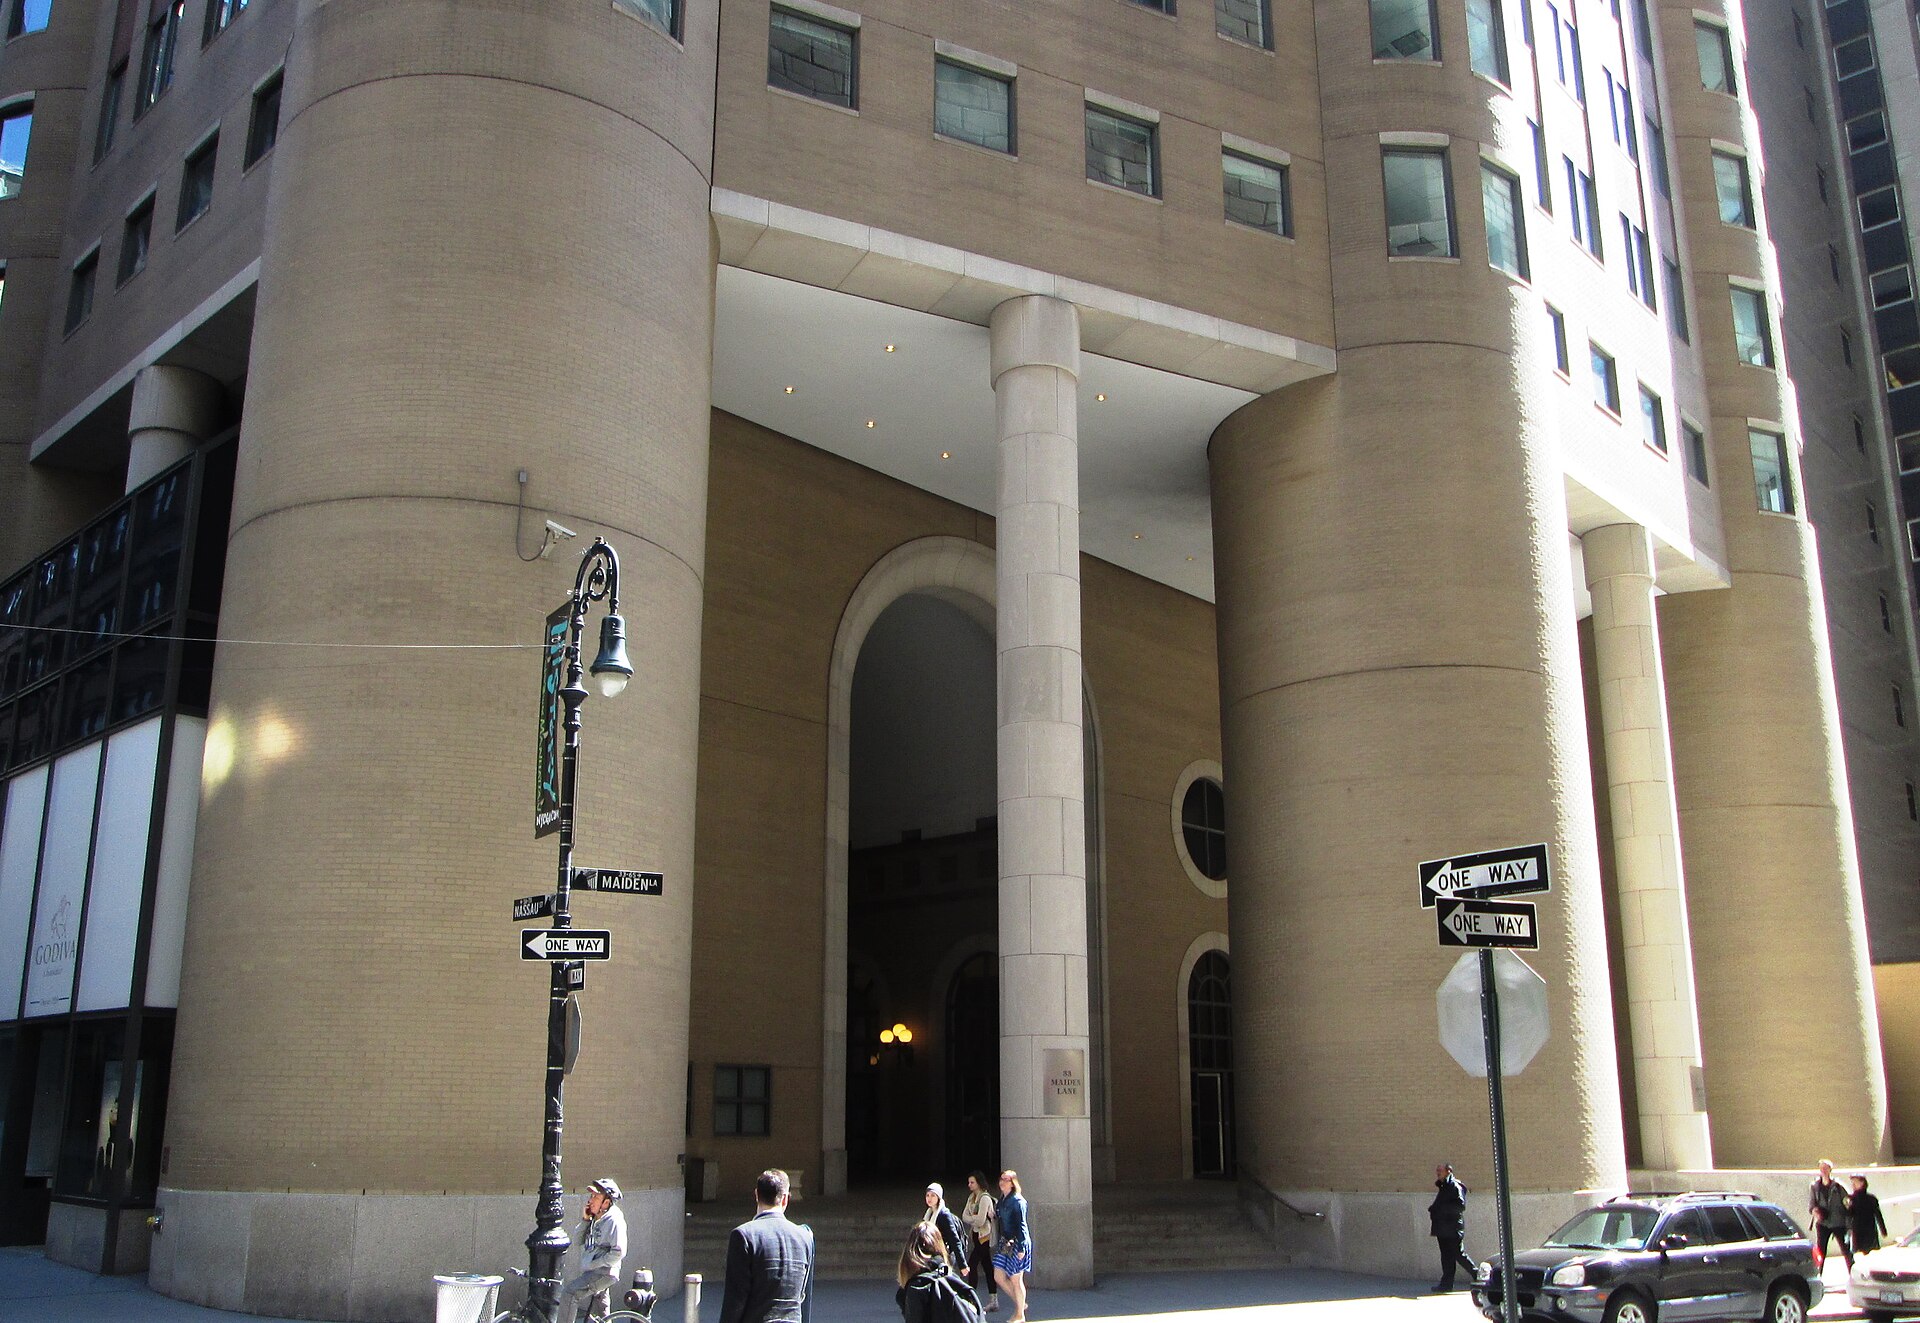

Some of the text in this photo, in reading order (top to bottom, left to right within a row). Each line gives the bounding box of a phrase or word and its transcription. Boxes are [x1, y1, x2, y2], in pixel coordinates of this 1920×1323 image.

[602, 875, 658, 891] MAIDEN LA
[1438, 861, 1529, 891] ONE WAY
[514, 902, 539, 918] NASSAU
[1453, 913, 1523, 935] ONE WAY
[35, 940, 77, 965] GODIVA
[545, 939, 601, 951] ONE WAY
